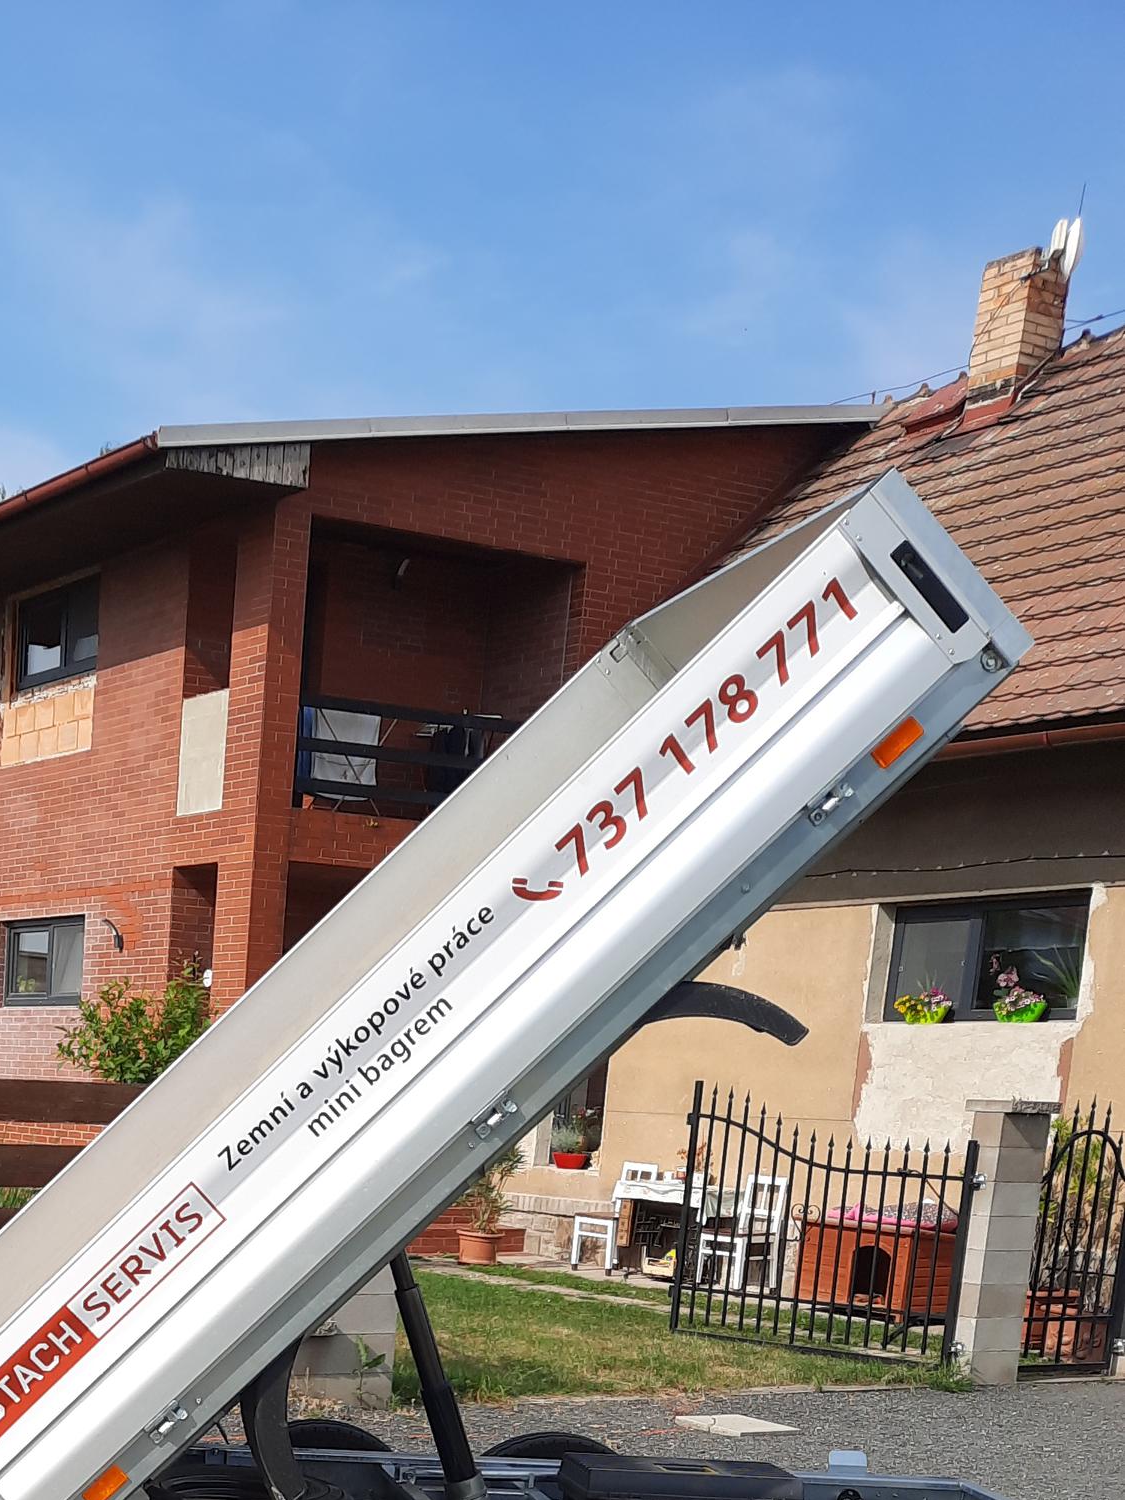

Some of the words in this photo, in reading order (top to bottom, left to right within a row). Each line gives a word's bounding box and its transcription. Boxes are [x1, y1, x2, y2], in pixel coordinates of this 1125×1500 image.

[555, 767, 648, 877] 737
[659, 674, 758, 775] 178
[756, 577, 858, 685] 771
[217, 1092, 295, 1171] Zemní
[296, 1080, 313, 1100] a
[313, 968, 426, 1080] výkopové
[427, 905, 494, 977] práce
[307, 1079, 362, 1138] mini
[357, 997, 454, 1085] bagrem
[82, 1201, 203, 1322] SERVIS
